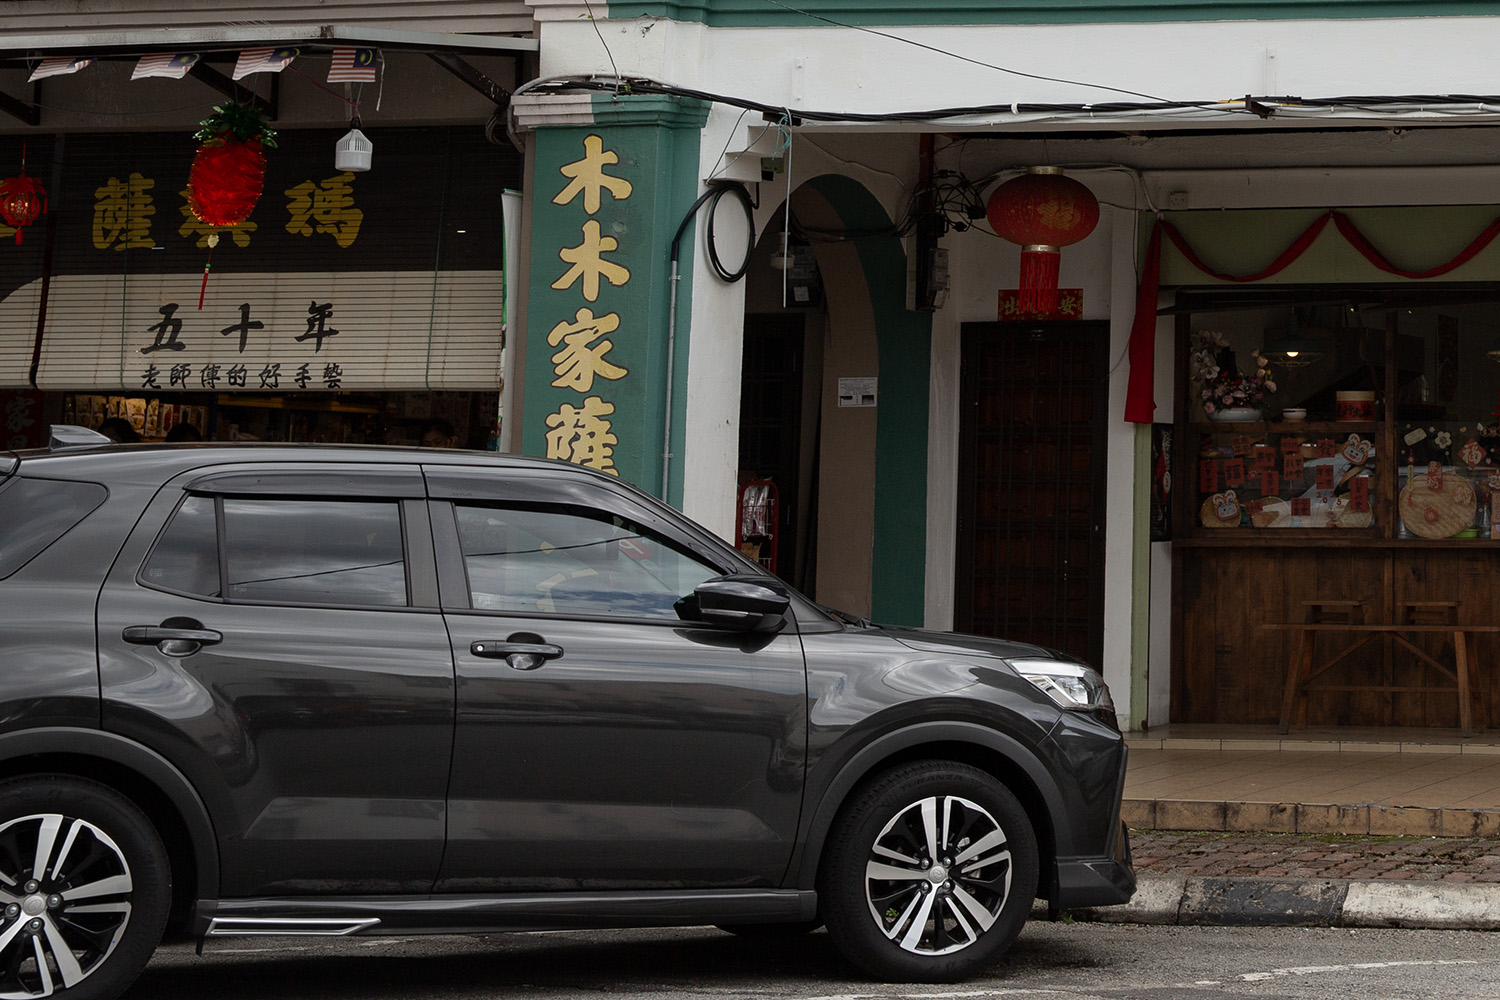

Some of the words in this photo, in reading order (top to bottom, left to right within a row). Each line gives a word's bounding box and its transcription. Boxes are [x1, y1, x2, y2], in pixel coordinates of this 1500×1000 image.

[1004, 295, 1078, 316] 出安
[140, 300, 340, 354] 五十年
[901, 773, 963, 791] TURANZA
